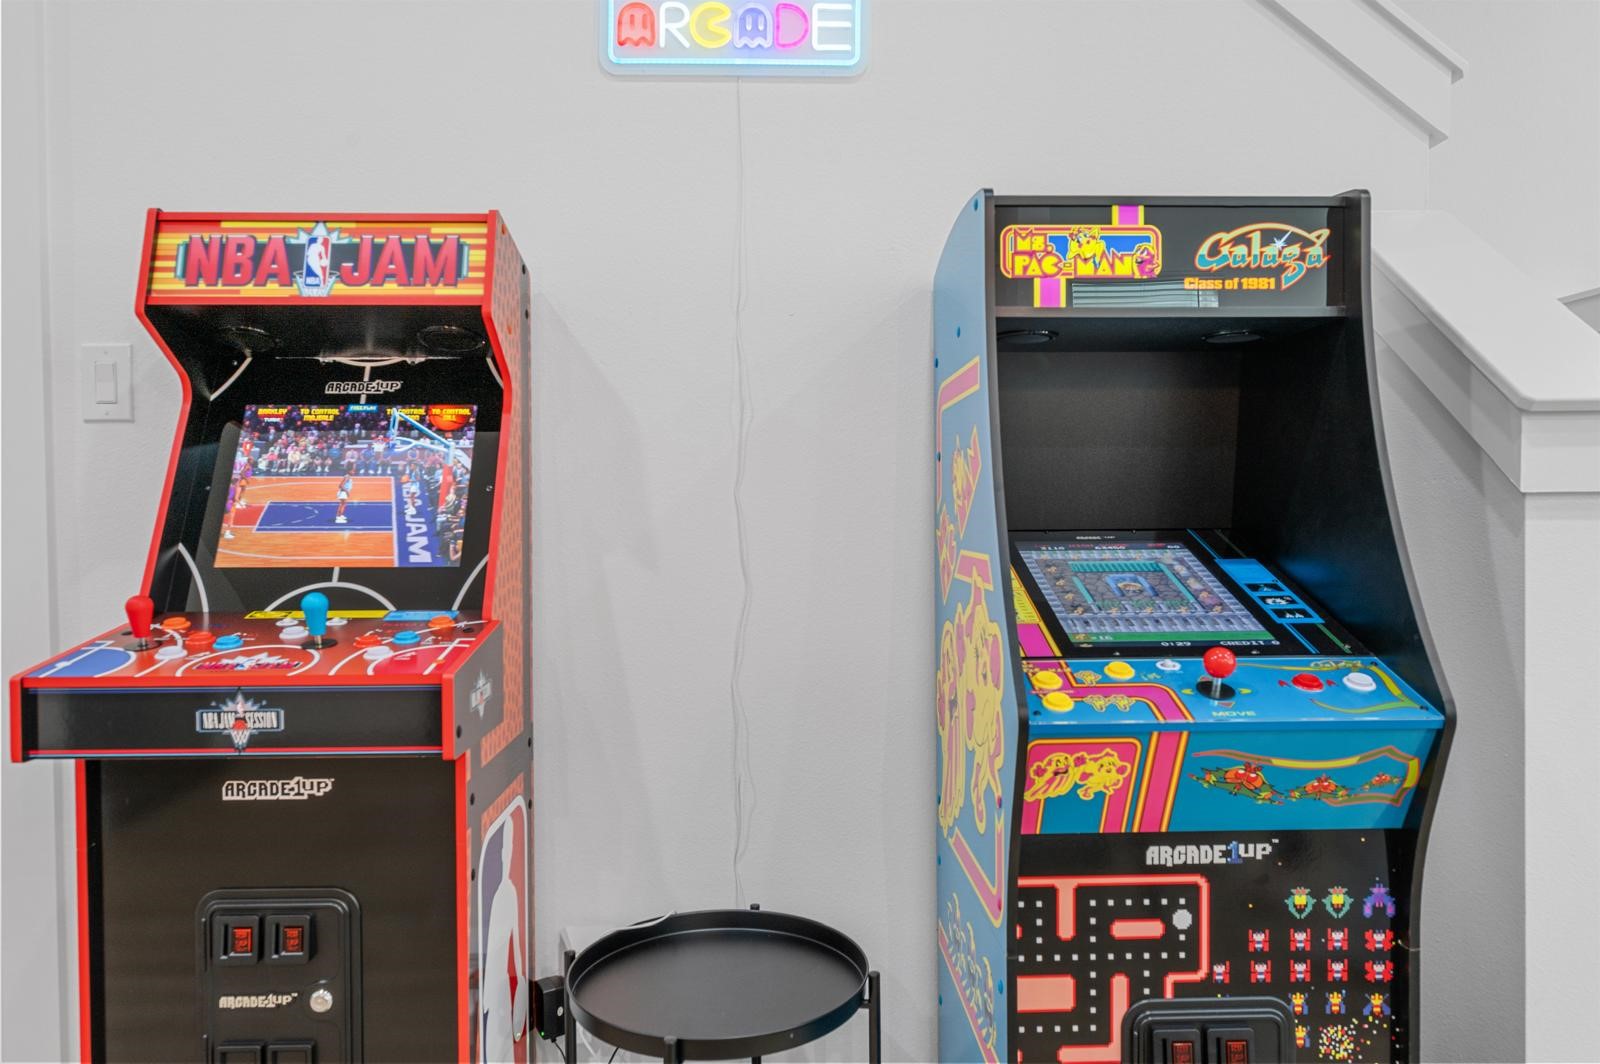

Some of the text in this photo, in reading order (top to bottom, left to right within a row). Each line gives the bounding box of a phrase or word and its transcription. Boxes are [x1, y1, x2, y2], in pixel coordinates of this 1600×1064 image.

[616, 1, 852, 50] ARCADE
[184, 234, 460, 287] NBA JAM
[1012, 249, 1135, 278] PAC-MAN
[1195, 222, 1332, 291] Galaga
[1184, 277, 1275, 290] Class of 1981
[405, 517, 432, 562] JAM
[1211, 710, 1257, 718] MOVE
